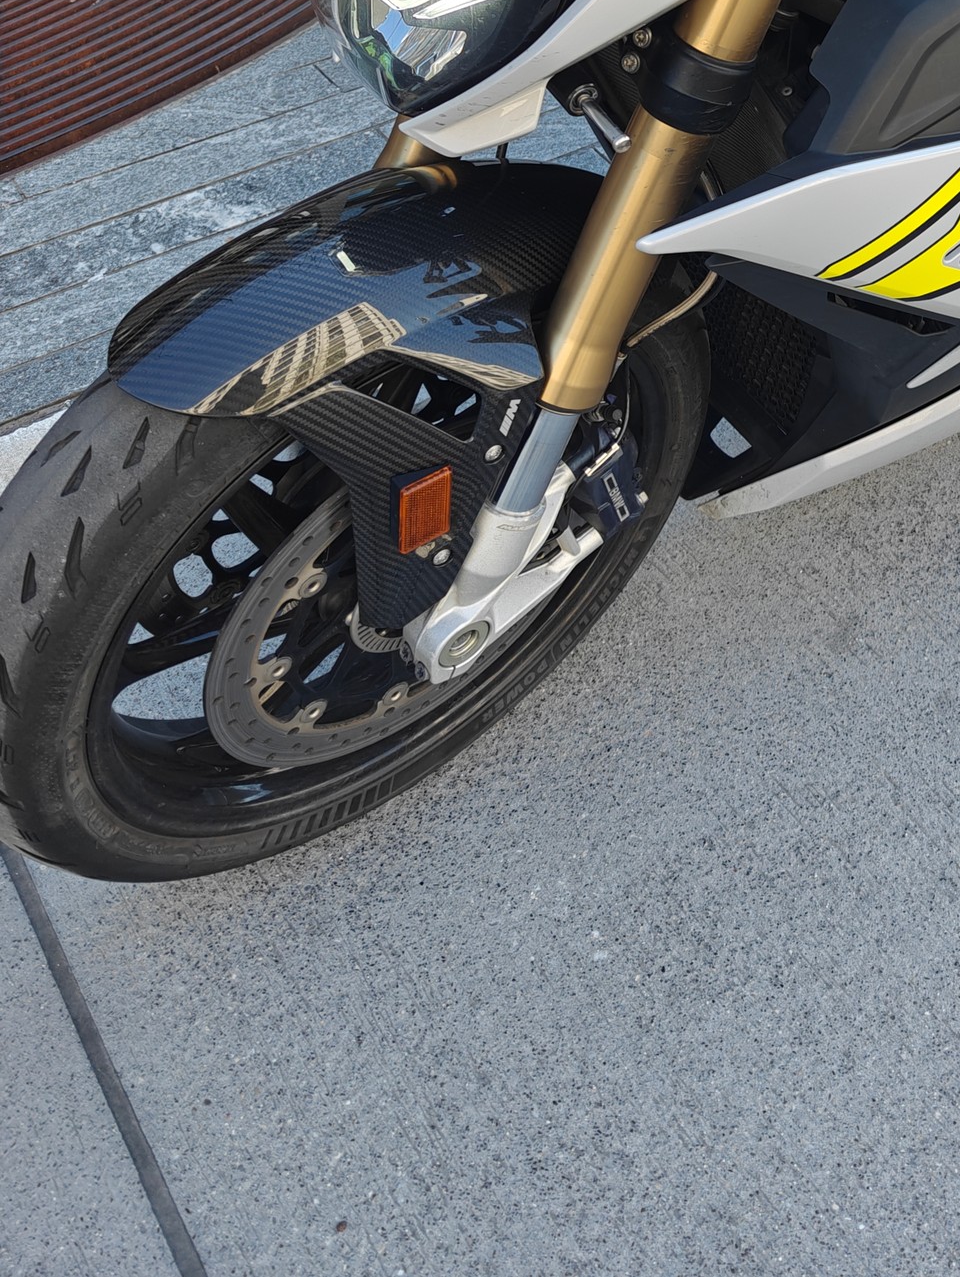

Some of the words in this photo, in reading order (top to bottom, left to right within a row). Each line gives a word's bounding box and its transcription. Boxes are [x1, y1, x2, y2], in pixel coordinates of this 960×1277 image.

[609, 487, 626, 510] BMW
[560, 547, 639, 650] MICHELIN
[482, 661, 548, 723] POWER
